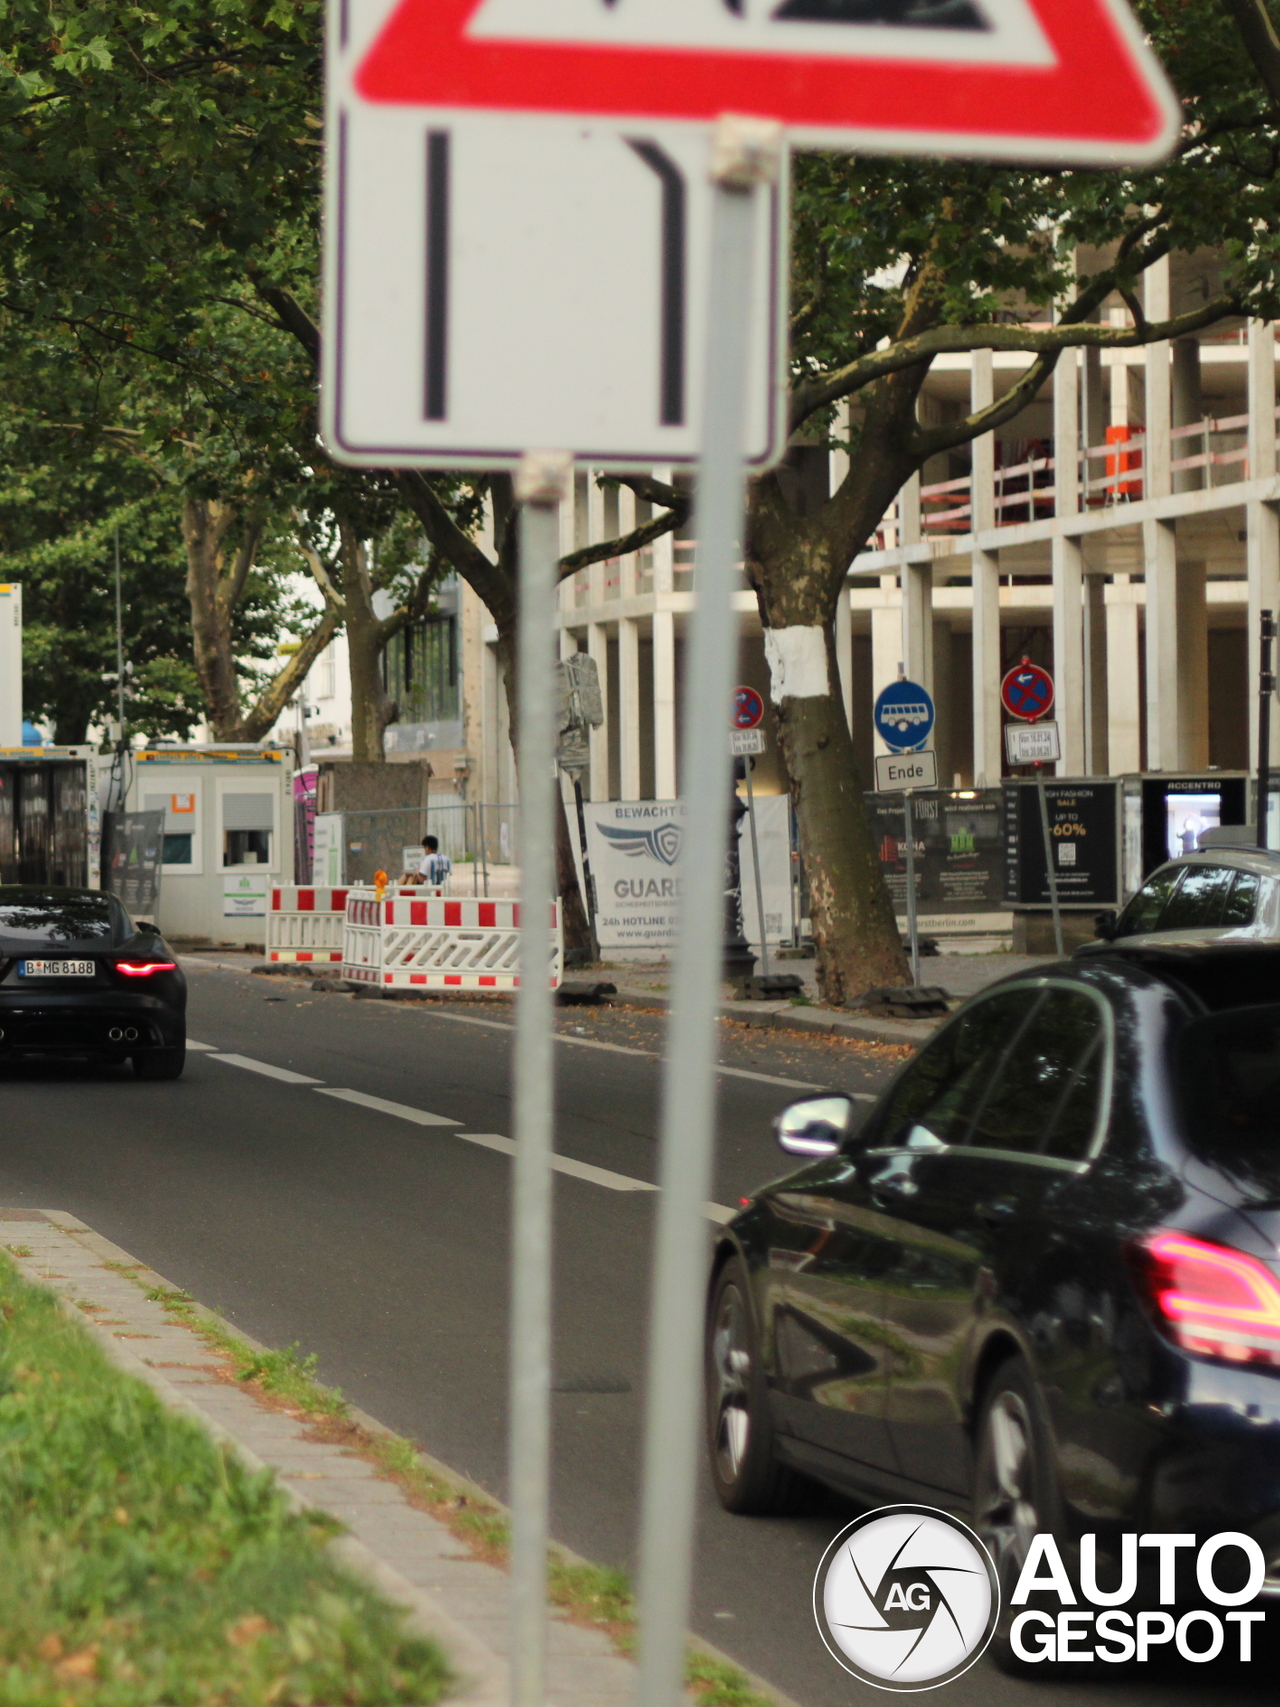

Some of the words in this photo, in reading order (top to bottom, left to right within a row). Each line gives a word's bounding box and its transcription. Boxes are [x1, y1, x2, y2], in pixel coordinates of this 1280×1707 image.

[888, 763, 924, 780] Ende
[1167, 781, 1222, 790] ACCENTRO
[1061, 789, 1093, 797] FASHION
[615, 806, 677, 818] BEWACHT
[602, 917, 620, 926] 24h
[623, 916, 666, 926] HOTLINE
[26, 962, 34, 974] B
[43, 962, 60, 974] MG
[62, 962, 93, 974] 8188
